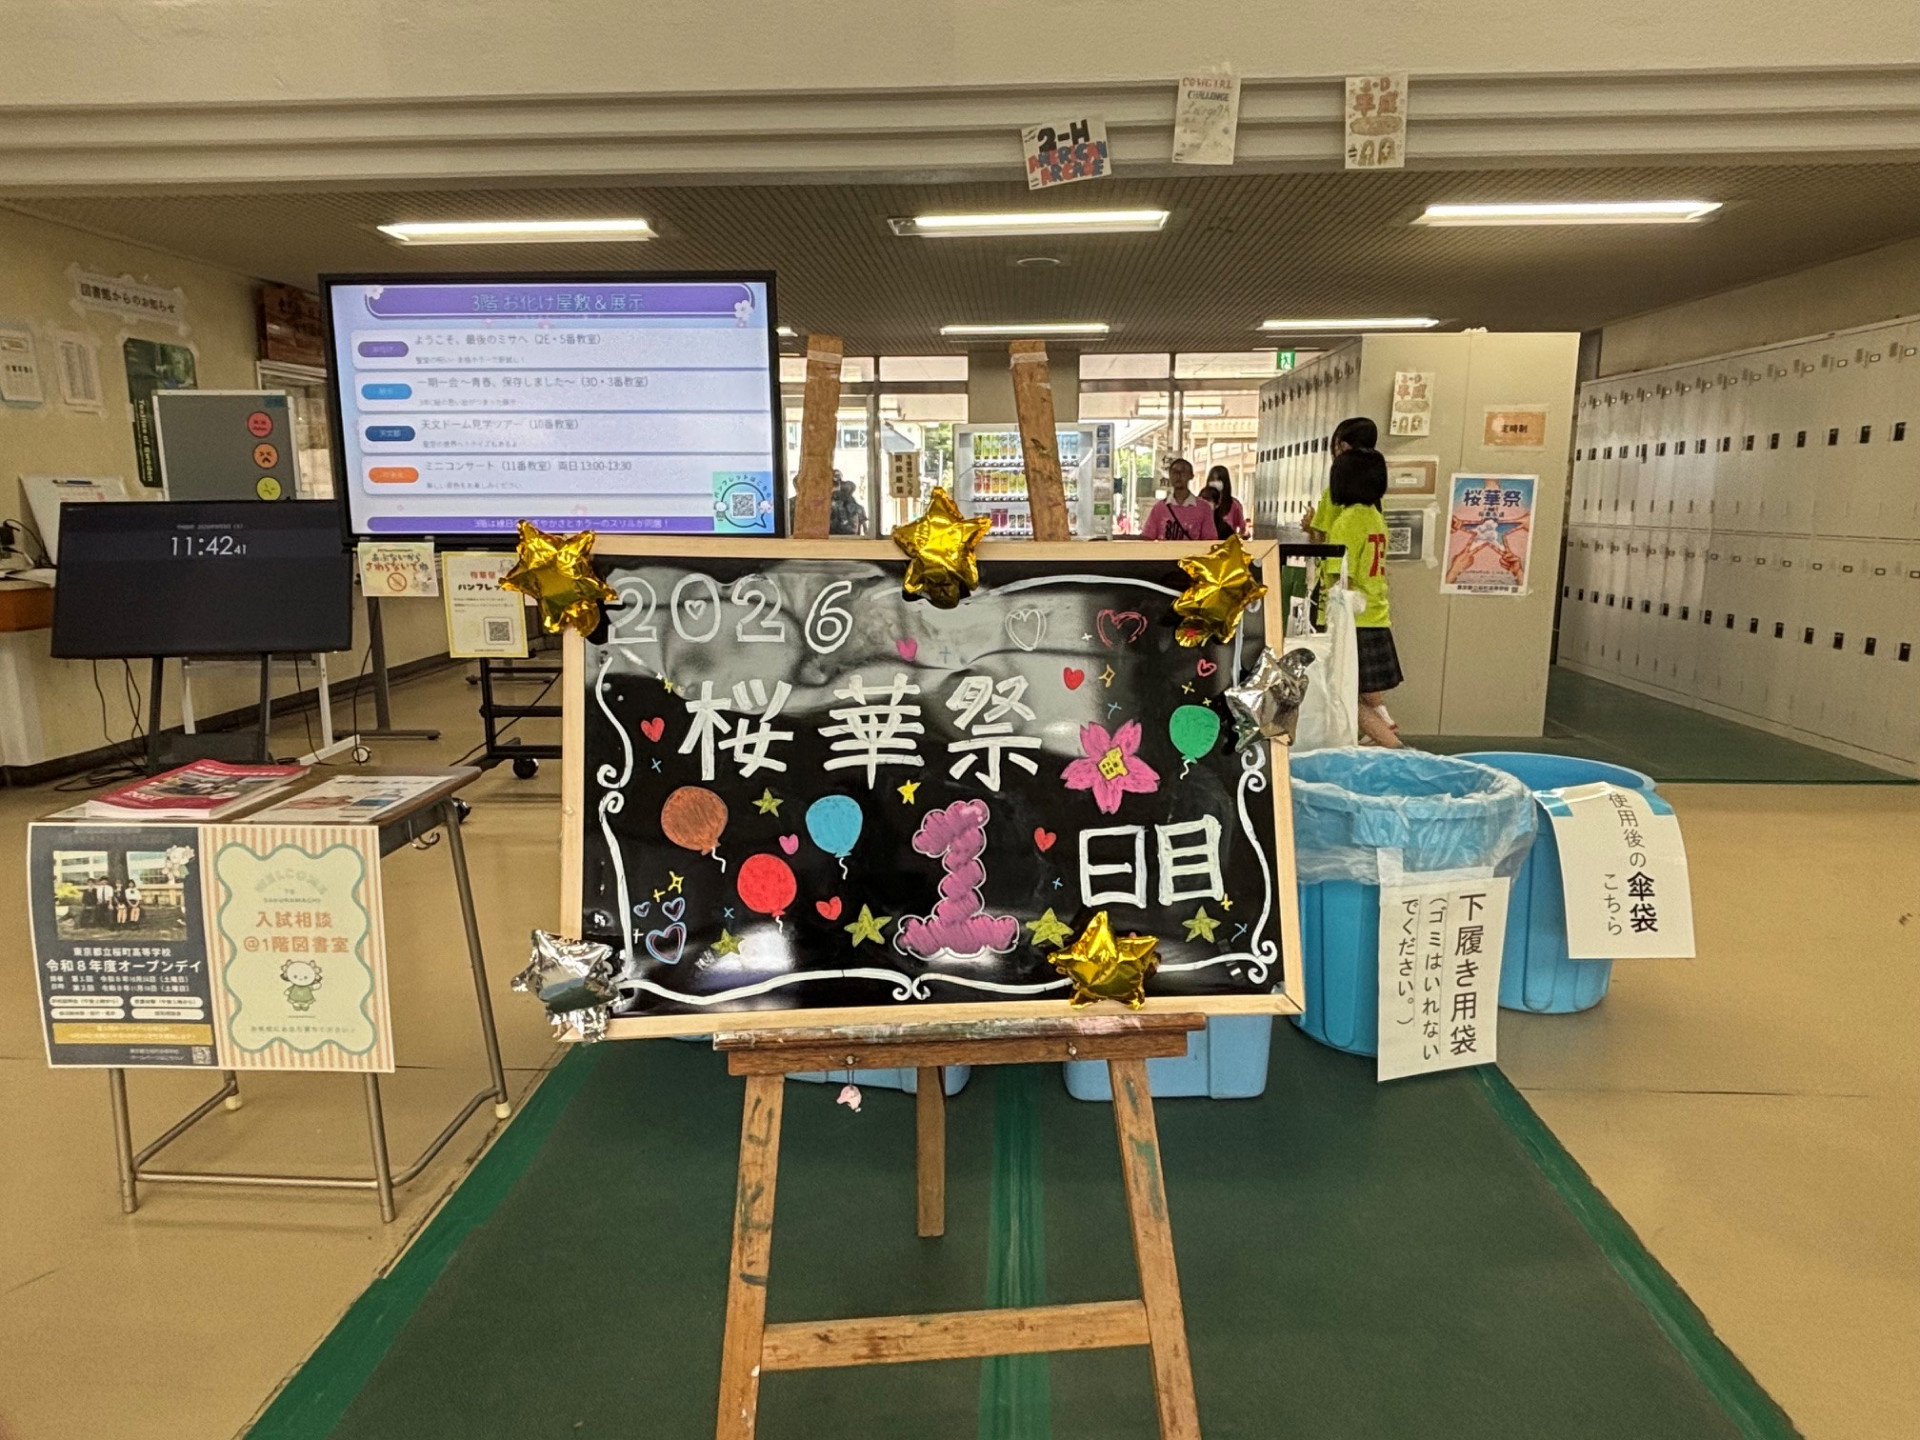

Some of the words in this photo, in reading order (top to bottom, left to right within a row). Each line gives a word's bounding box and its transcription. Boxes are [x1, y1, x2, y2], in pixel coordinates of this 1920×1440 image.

[1037, 119, 1090, 152] 2-H
[1028, 141, 1108, 174] AMERICAN
[1041, 159, 1104, 186] ARCADE
[1463, 488, 1522, 508] 桜華祭
[171, 535, 234, 557] 11:42
[234, 544, 247, 555] 41
[604, 573, 855, 655] 2026
[678, 672, 1042, 793] 桜華祭
[1608, 792, 1659, 934] 使用後の傘袋
[255, 911, 334, 928] 入試相談
[1603, 873, 1623, 936] こちら
[243, 935, 350, 953] @1階図書室
[45, 959, 202, 973] 令和8年度オープンデイ
[1450, 892, 1487, 1056] 下履き用袋
